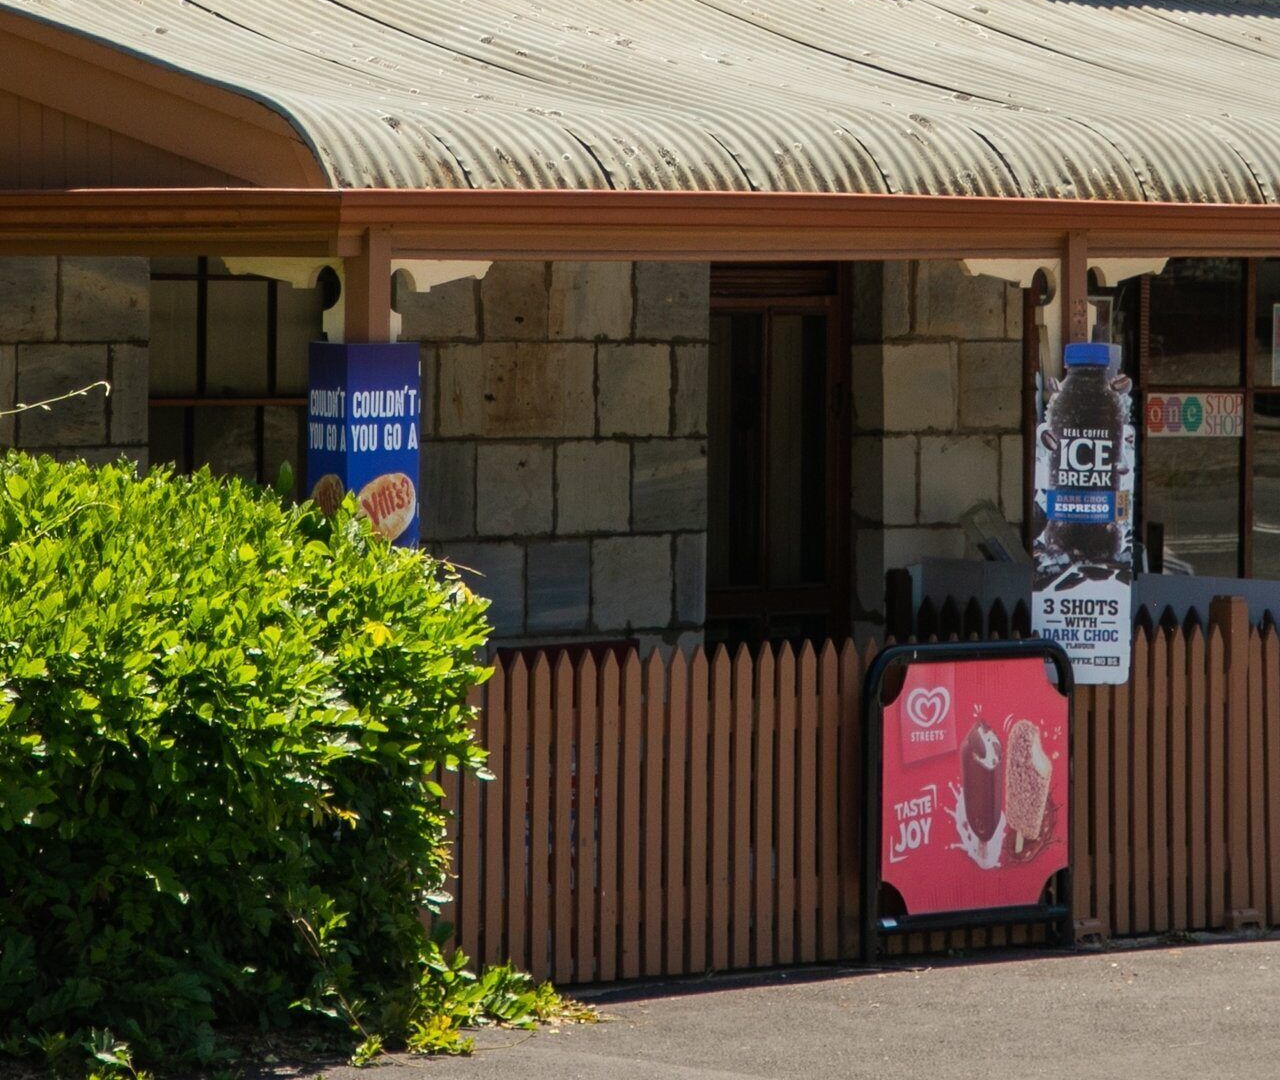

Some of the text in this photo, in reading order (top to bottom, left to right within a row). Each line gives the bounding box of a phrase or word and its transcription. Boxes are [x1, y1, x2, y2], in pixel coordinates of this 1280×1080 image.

[310, 386, 346, 418] COULDN'T
[352, 385, 417, 418] COULDN'T
[1206, 394, 1243, 415] STOP
[1063, 428, 1109, 438] REAL COFFEE
[1205, 415, 1242, 435] SHOP
[310, 423, 346, 452] YOU GO A
[351, 422, 418, 452] YOU GO A
[1059, 438, 1112, 471] ICE
[1058, 471, 1112, 486] BREAK
[1054, 503, 1109, 513] ESPRESSO
[1043, 598, 1118, 615] 3 SHOTS
[1065, 617, 1097, 628] WITH
[1042, 628, 1118, 642] DARK CHOC
[911, 730, 945, 742] STREETS
[894, 794, 932, 820] TASTE
[894, 818, 932, 852] JOY
